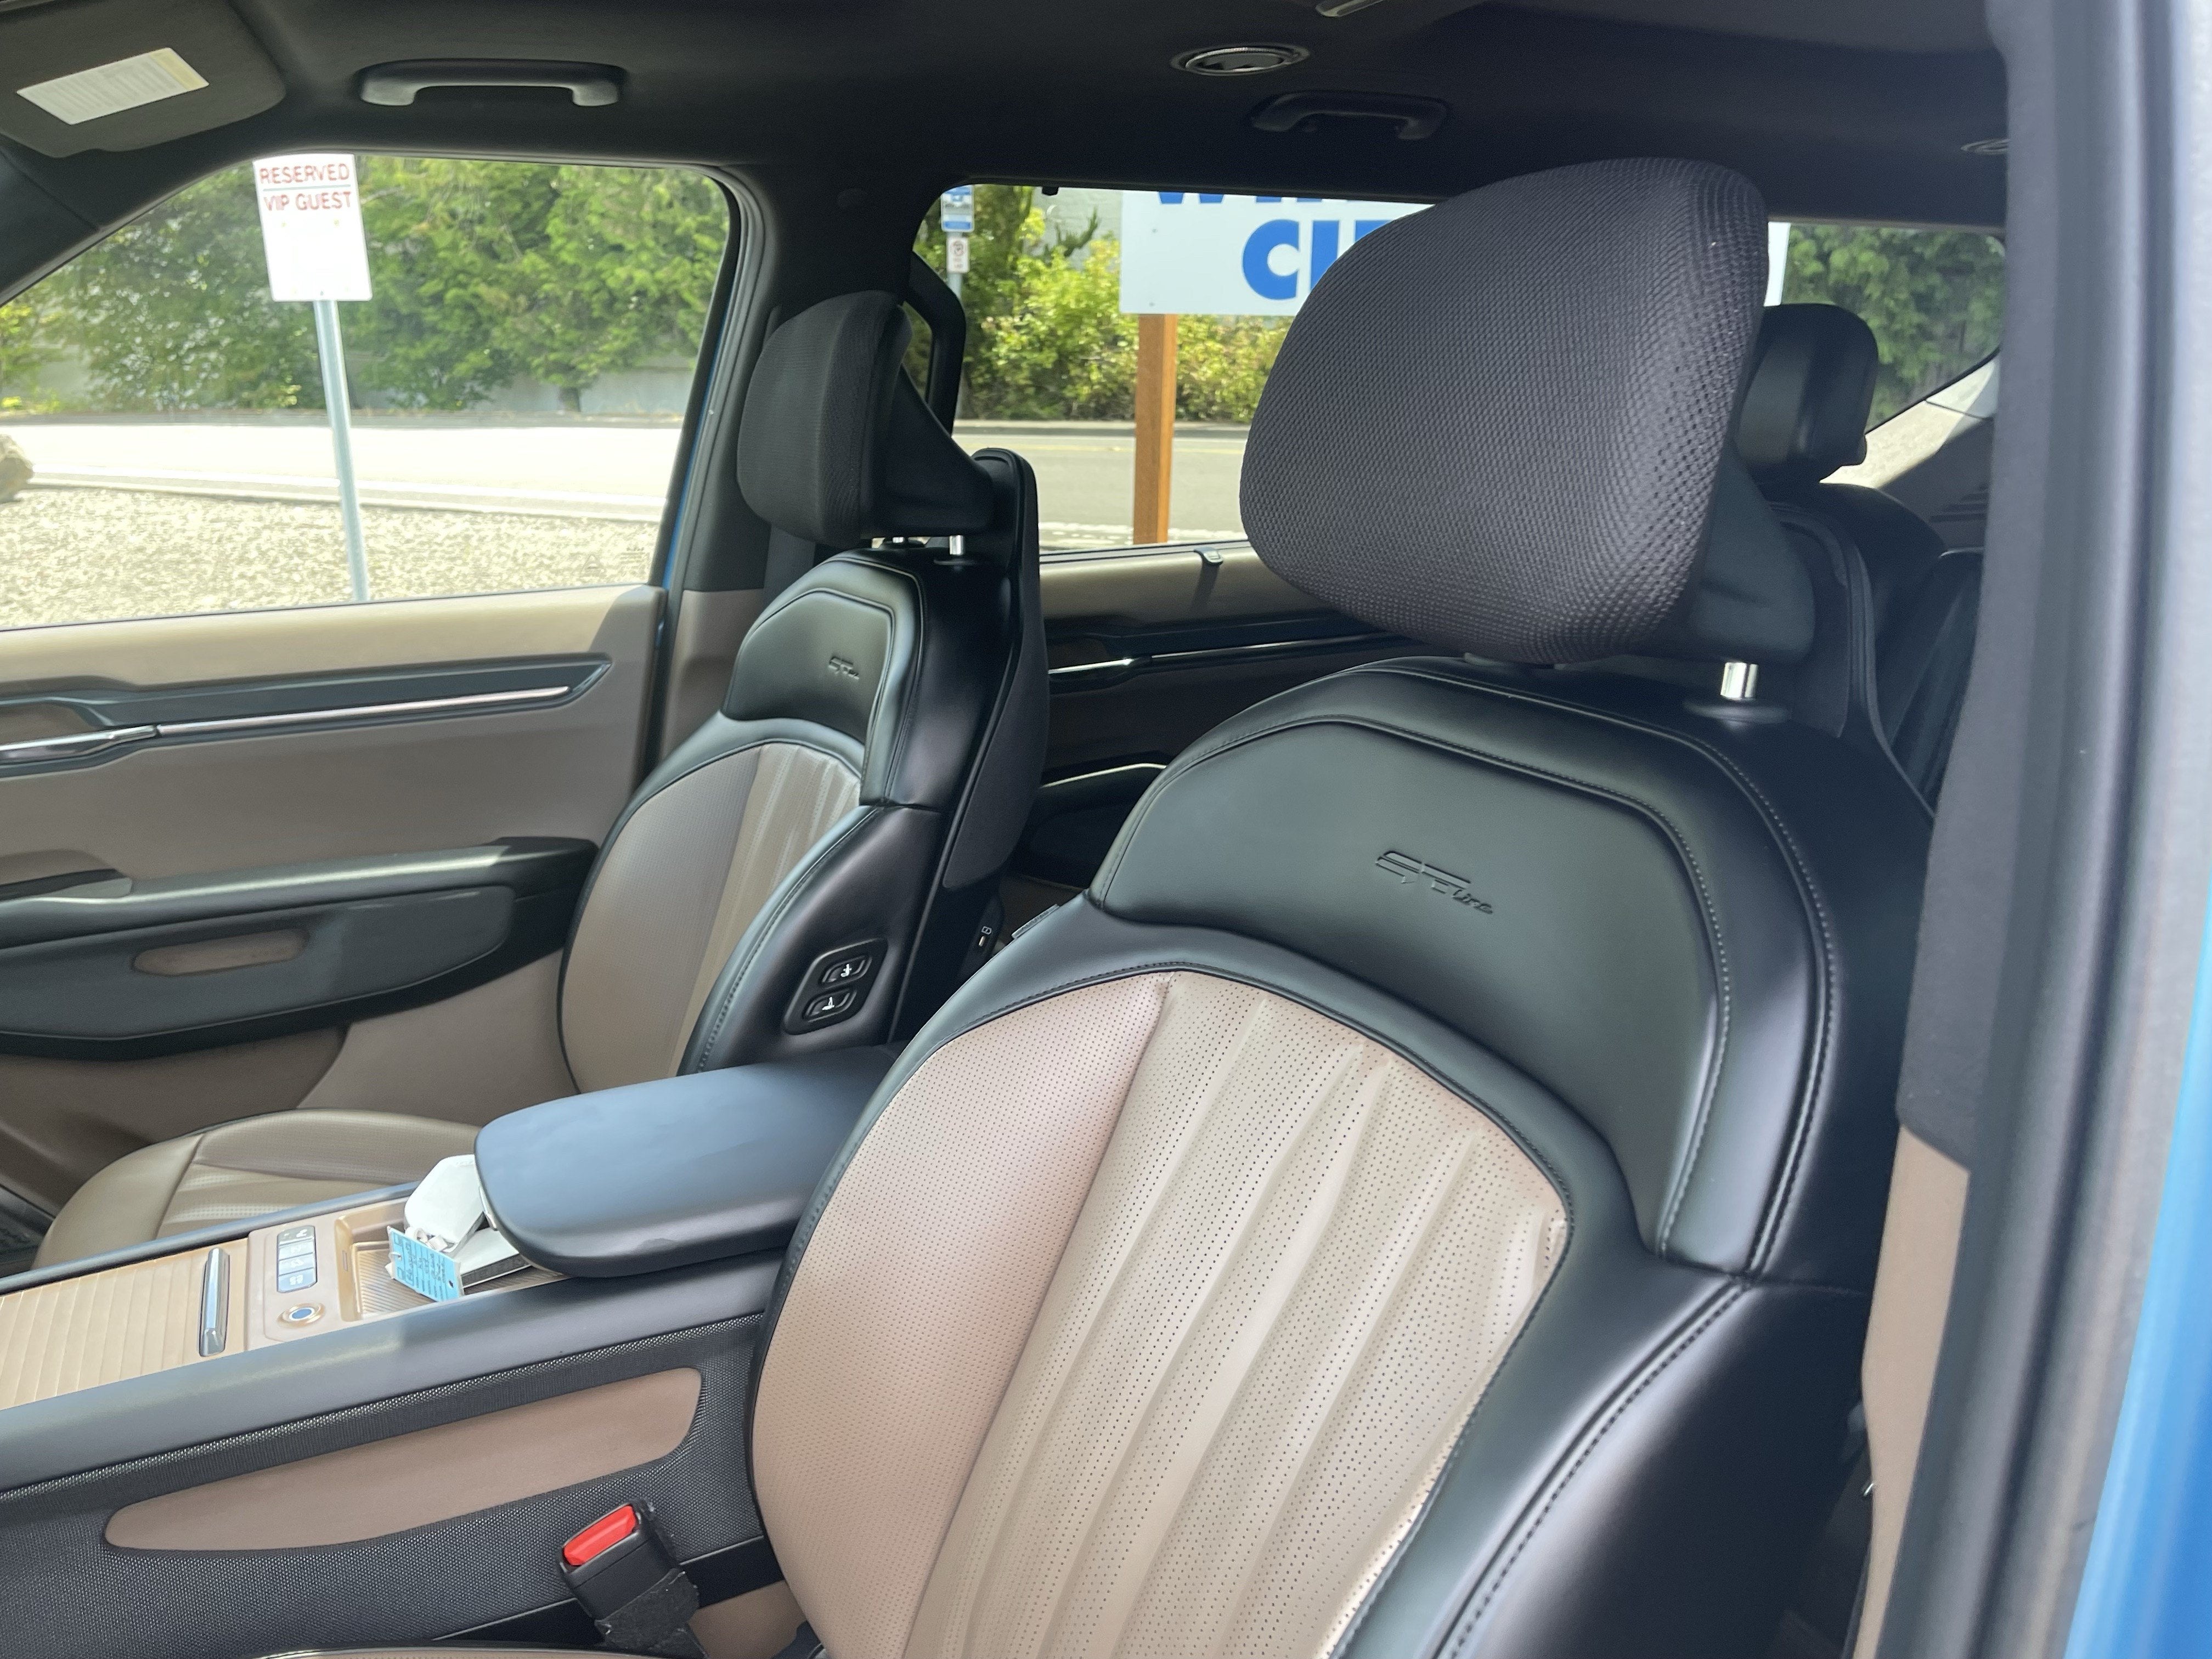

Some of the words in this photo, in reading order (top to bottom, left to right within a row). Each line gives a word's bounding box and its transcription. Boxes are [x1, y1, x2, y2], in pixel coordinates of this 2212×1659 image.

[259, 163, 350, 184] RESERVED
[263, 194, 290, 211] VIP
[295, 191, 352, 211] GUEST
